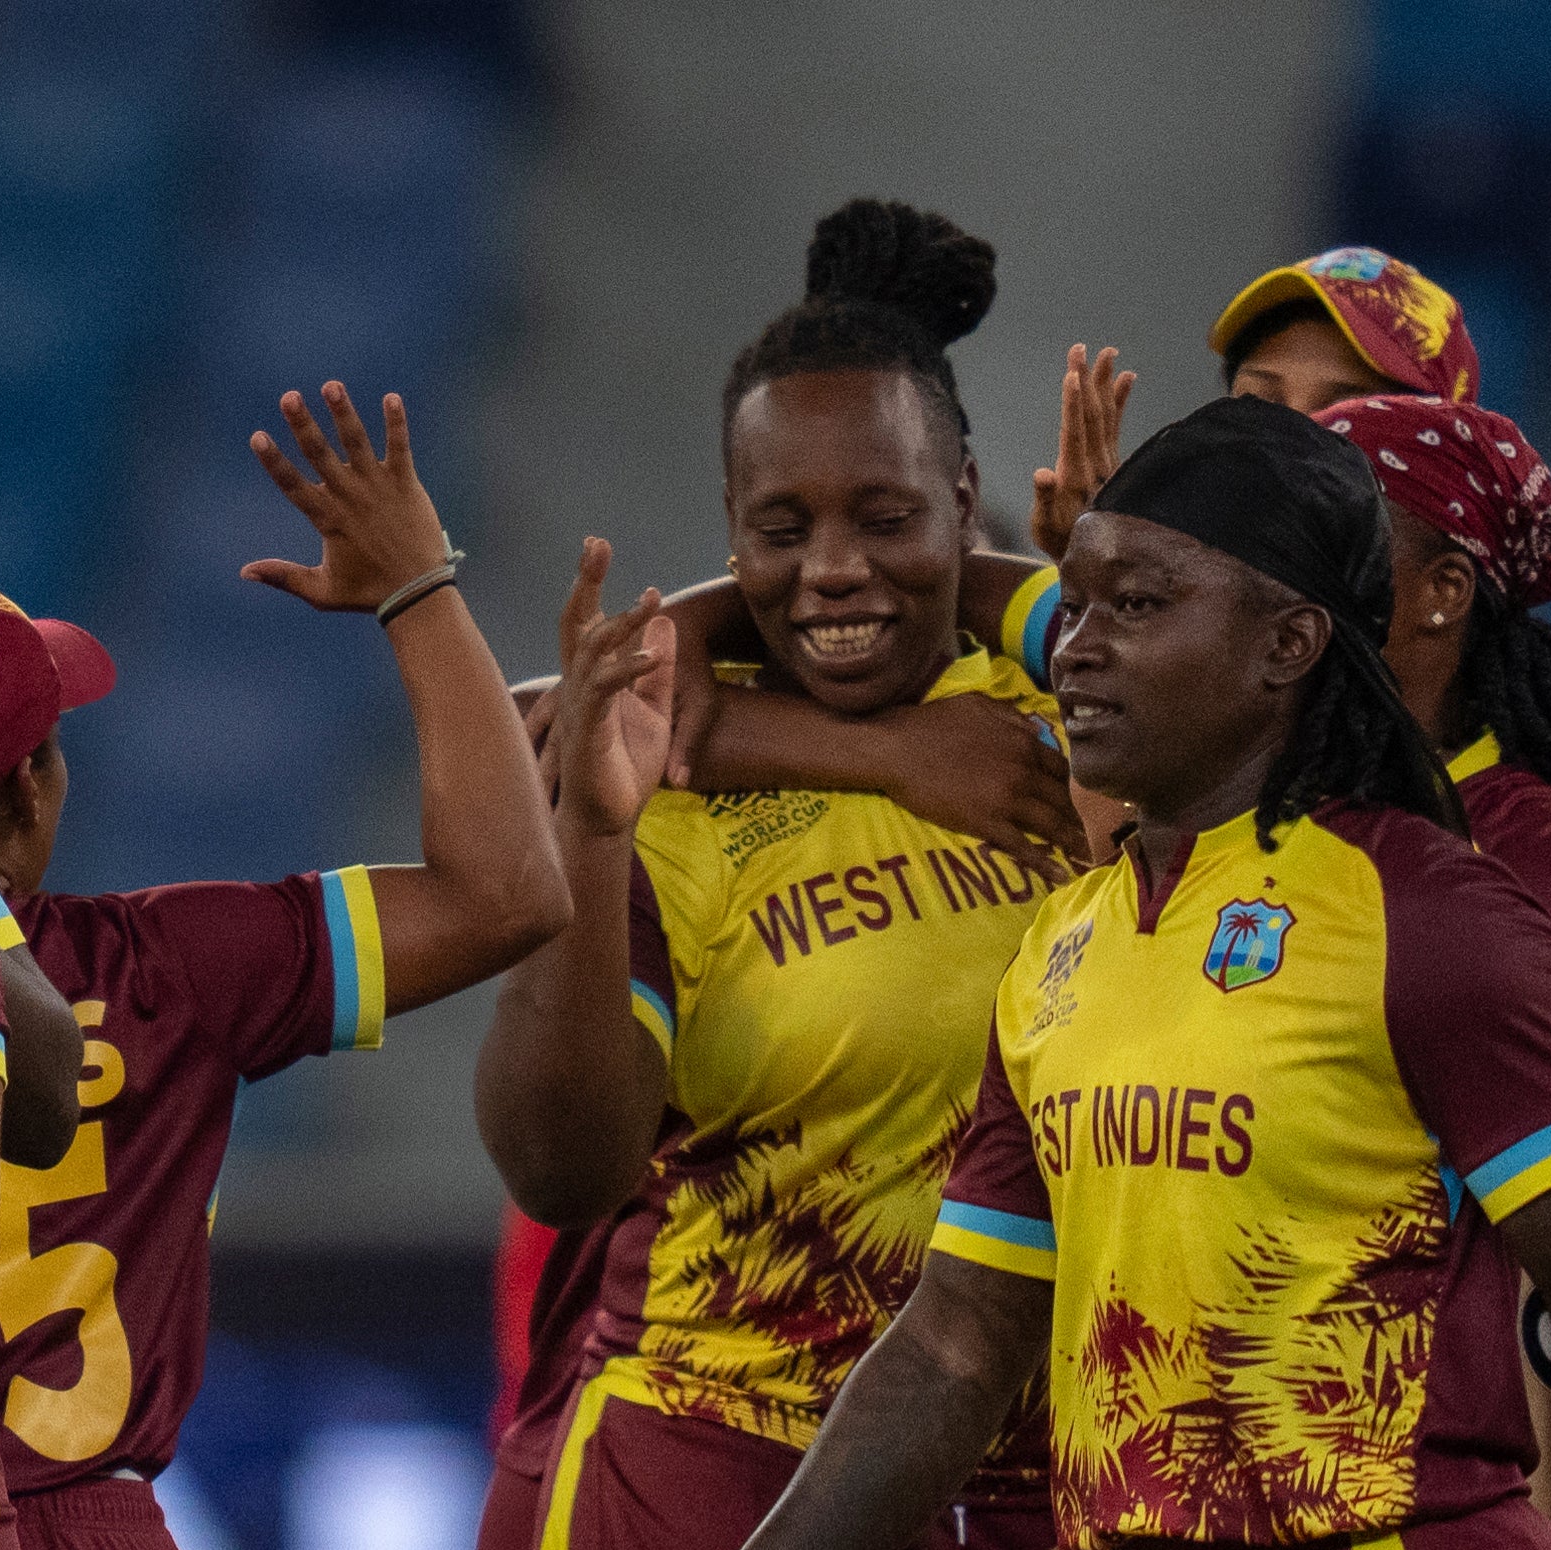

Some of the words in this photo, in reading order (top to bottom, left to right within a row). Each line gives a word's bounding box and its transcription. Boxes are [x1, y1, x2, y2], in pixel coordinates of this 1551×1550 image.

[722, 813, 789, 858] WORLD
[791, 798, 831, 823] CUP
[748, 854, 923, 968] WEST
[1092, 1084, 1255, 1178] INDIES
